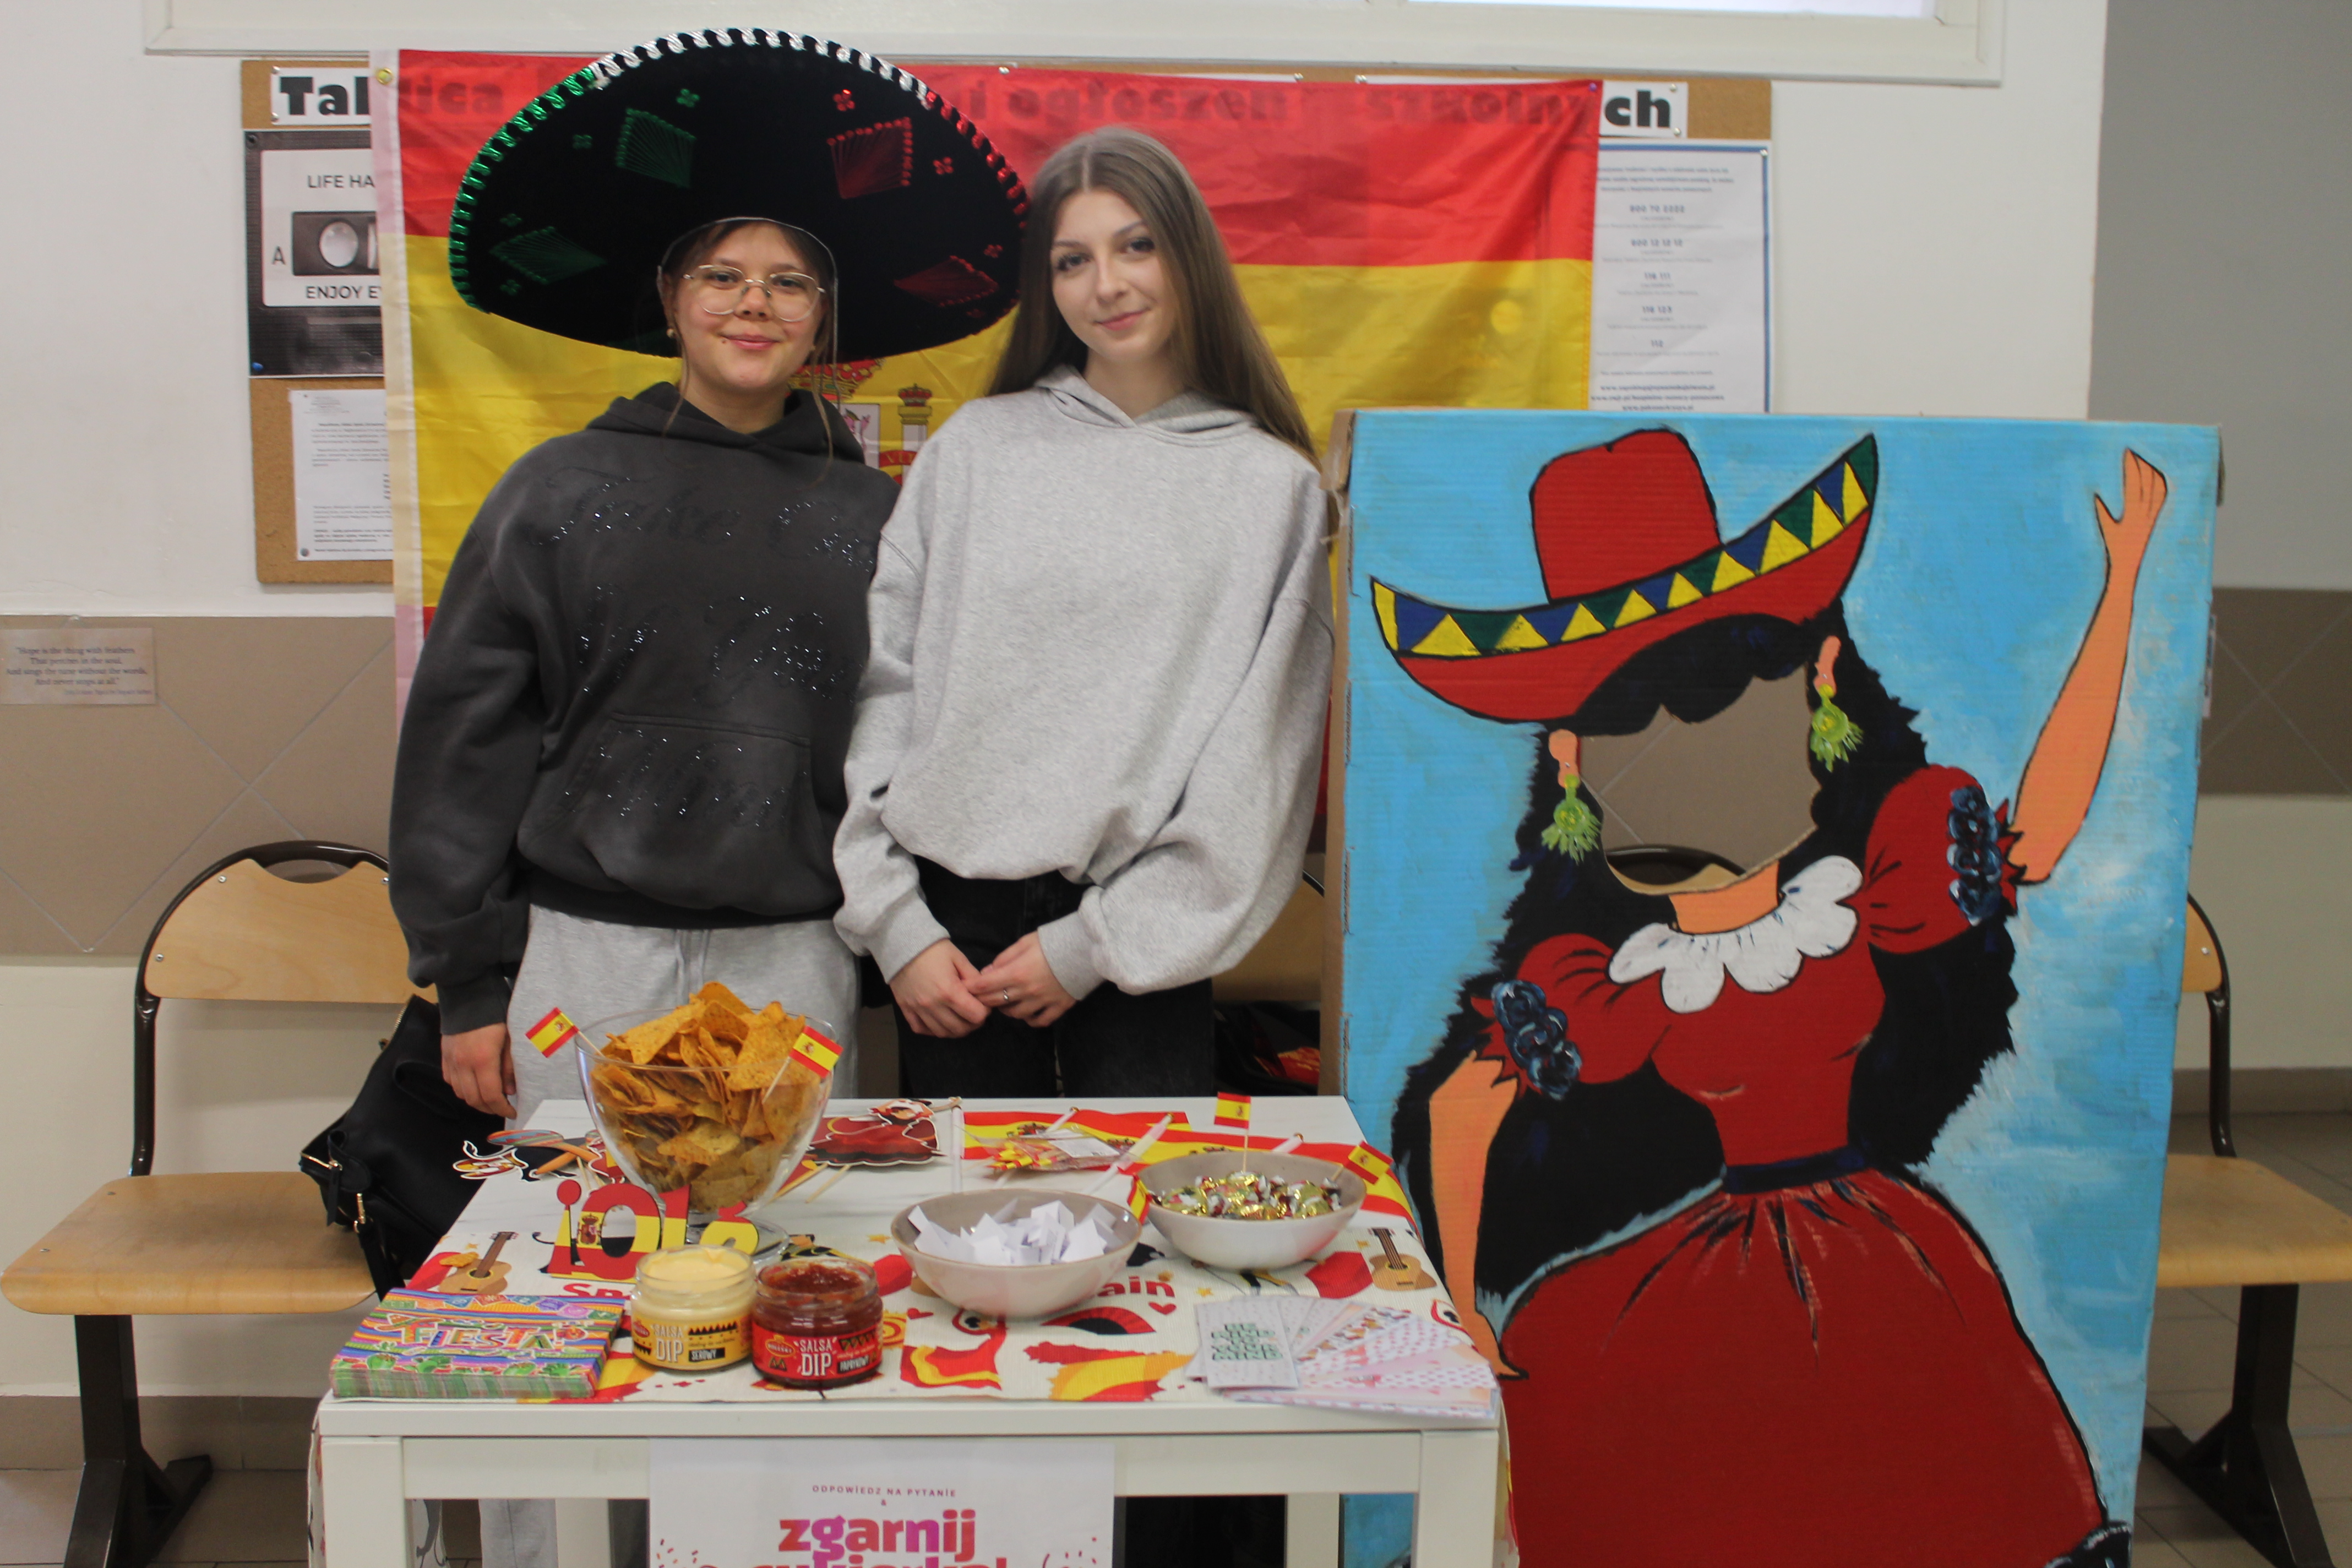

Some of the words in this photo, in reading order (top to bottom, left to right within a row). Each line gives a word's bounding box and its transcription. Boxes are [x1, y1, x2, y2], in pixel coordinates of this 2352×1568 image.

[308, 175, 344, 188] LIFE
[273, 246, 286, 265] A
[306, 285, 362, 298] ENJOY
[368, 285, 382, 298] E
[563, 1283, 630, 1300] Sp
[1097, 1276, 1175, 1298] ain
[654, 1324, 684, 1338] SALSA
[656, 1338, 683, 1363] DIP
[799, 1338, 832, 1352] SALSA
[801, 1352, 832, 1376] DIP
[778, 1509, 976, 1562] zgarnij
